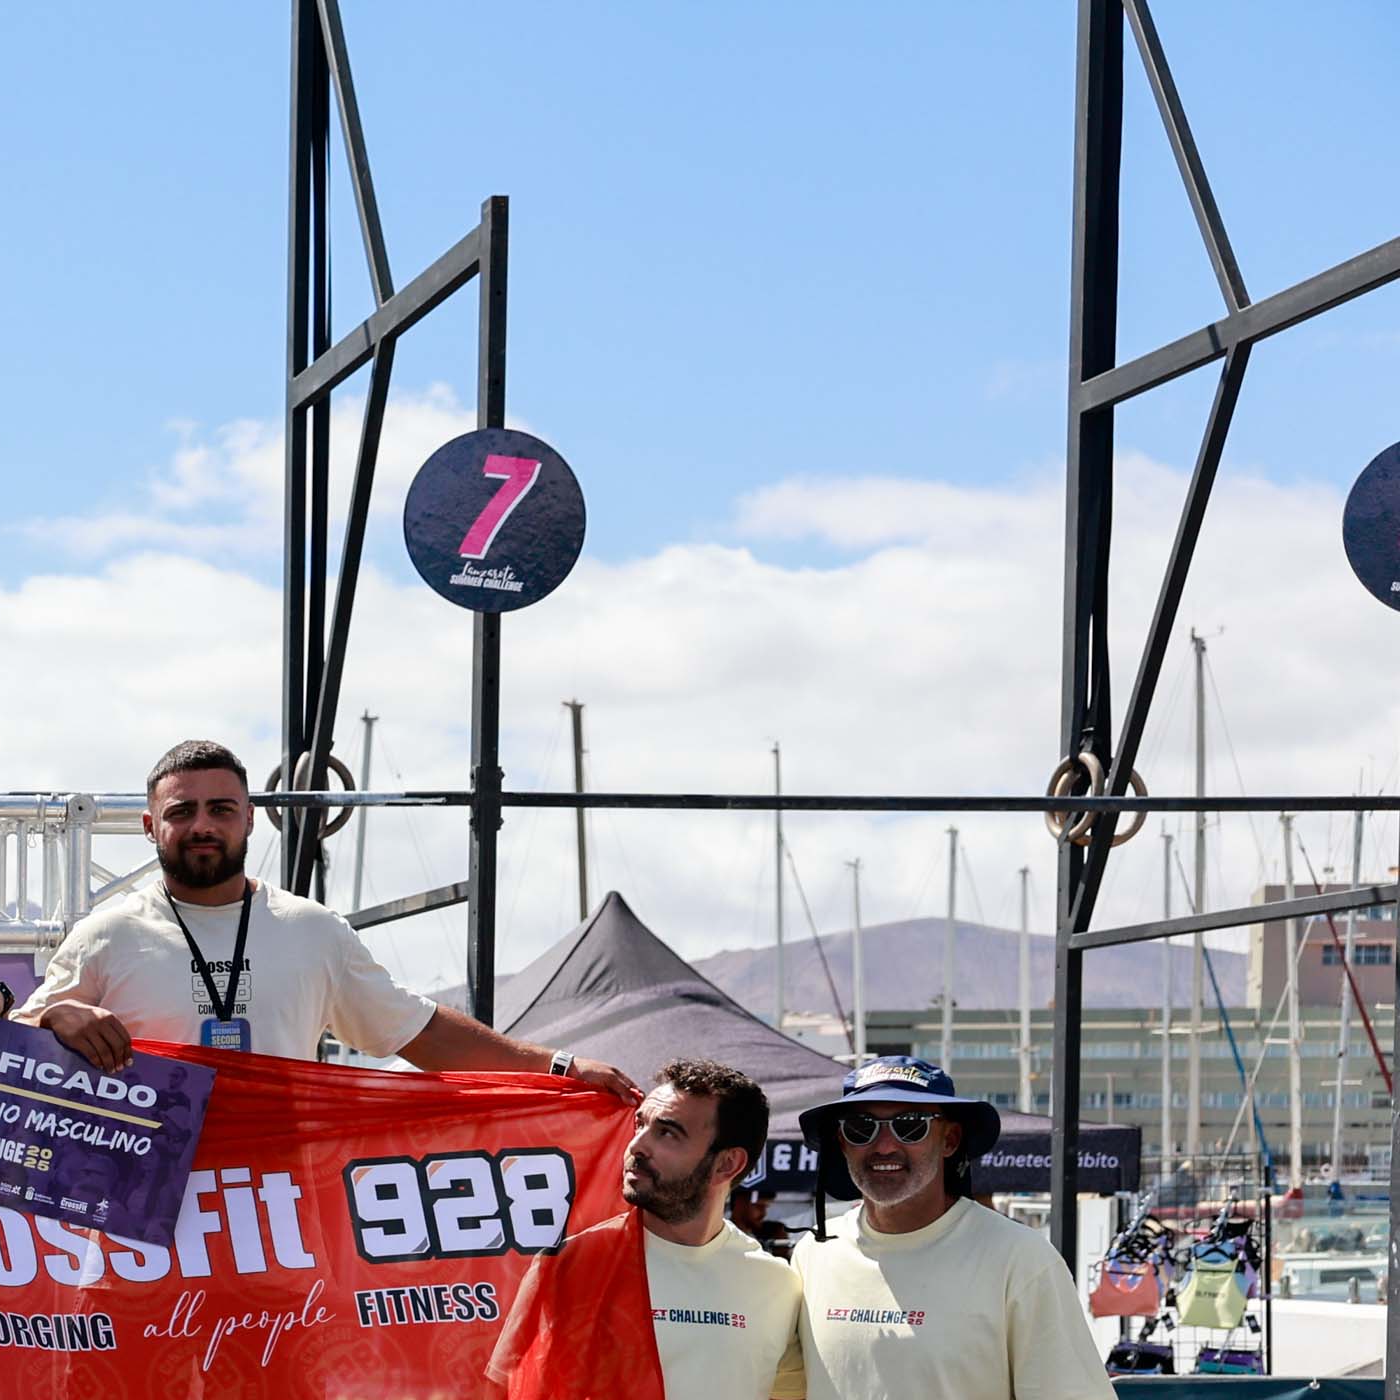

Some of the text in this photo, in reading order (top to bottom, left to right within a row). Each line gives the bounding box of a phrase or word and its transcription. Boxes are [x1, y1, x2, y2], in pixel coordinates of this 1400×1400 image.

[458, 454, 542, 560] 7
[449, 574, 524, 592] SUMMER CHALLENGE
[24, 1109, 152, 1156] MASCULINO
[343, 1147, 577, 1263] 928
[143, 1289, 204, 1340] all
[202, 1278, 337, 1371] people
[353, 1281, 499, 1327] FITNESS
[669, 1309, 730, 1326] CHALLENGE
[850, 1309, 907, 1324] CHALLENGE
